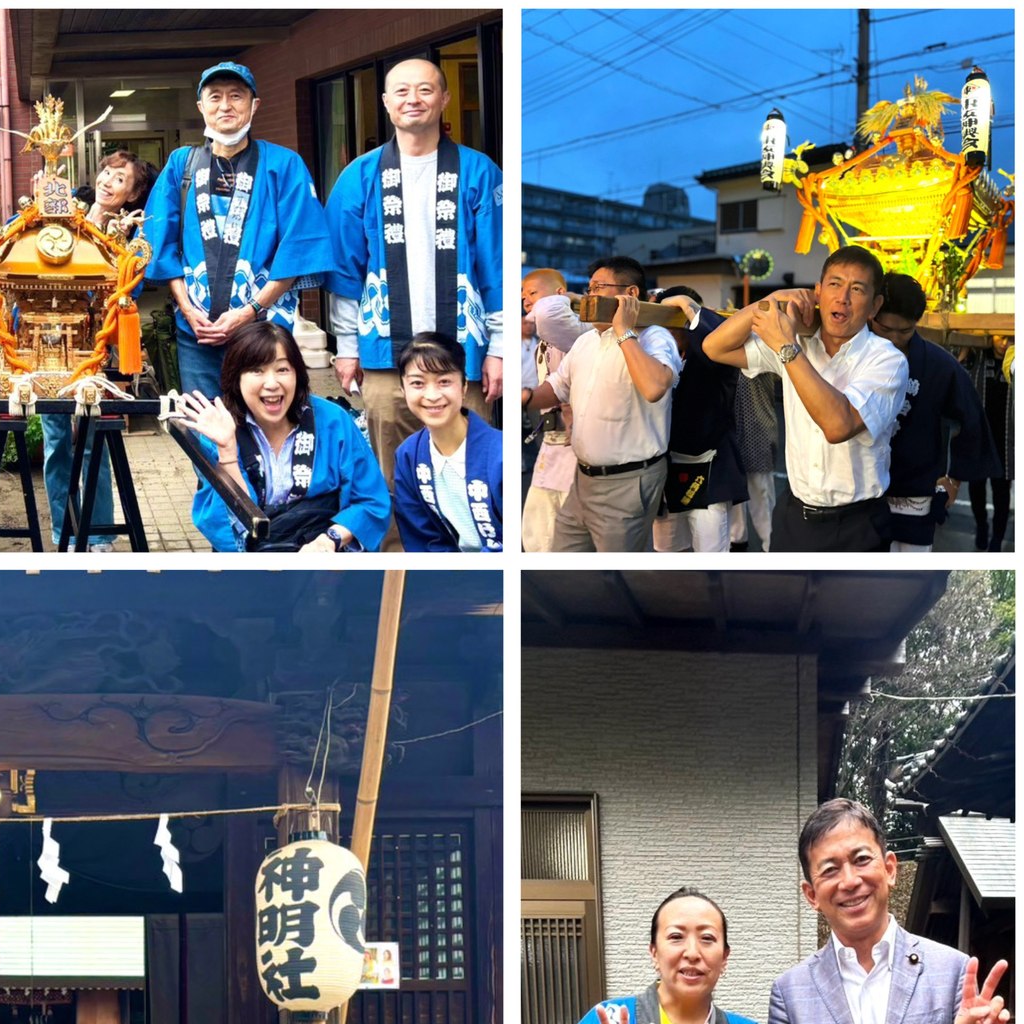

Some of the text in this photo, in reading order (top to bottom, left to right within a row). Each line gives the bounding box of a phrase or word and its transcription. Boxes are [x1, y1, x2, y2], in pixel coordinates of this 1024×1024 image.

[43, 181, 69, 214] 北部
[257, 847, 324, 1002] 神明社
